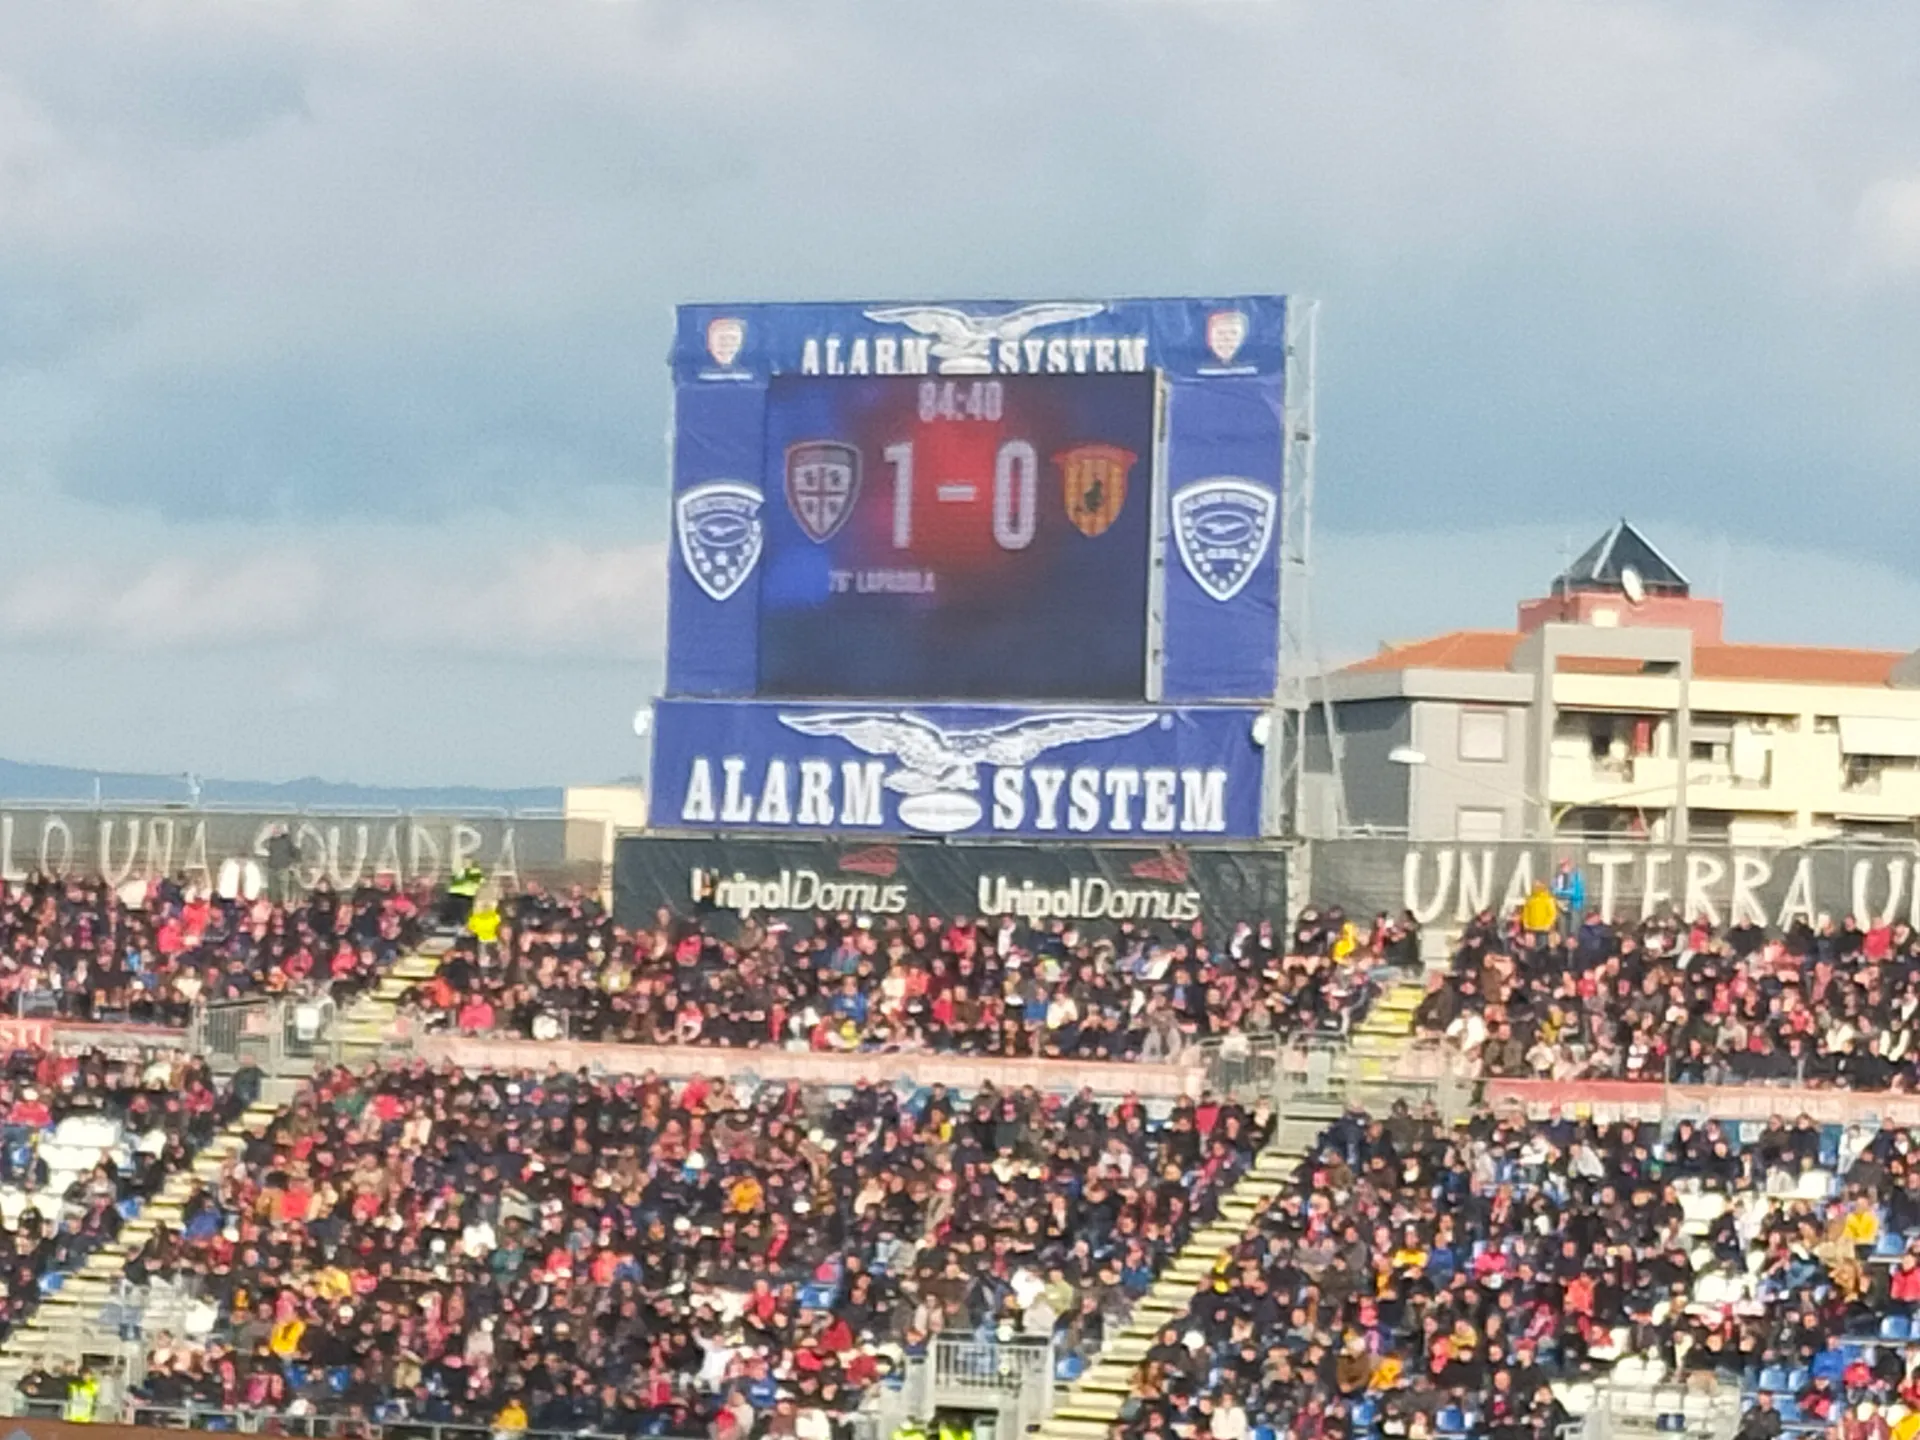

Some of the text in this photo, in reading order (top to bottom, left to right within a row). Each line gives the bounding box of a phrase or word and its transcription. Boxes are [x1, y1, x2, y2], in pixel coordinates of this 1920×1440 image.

[801, 337, 1147, 375] ALARM SYSTEM
[883, 439, 914, 550] 1
[993, 438, 1038, 551] 0
[681, 757, 1228, 832] ALARM SYSTEM
[100, 816, 213, 890] UNA
[977, 873, 1201, 929] UnipolDomus
[1403, 850, 1920, 937] UNA TERRA U
